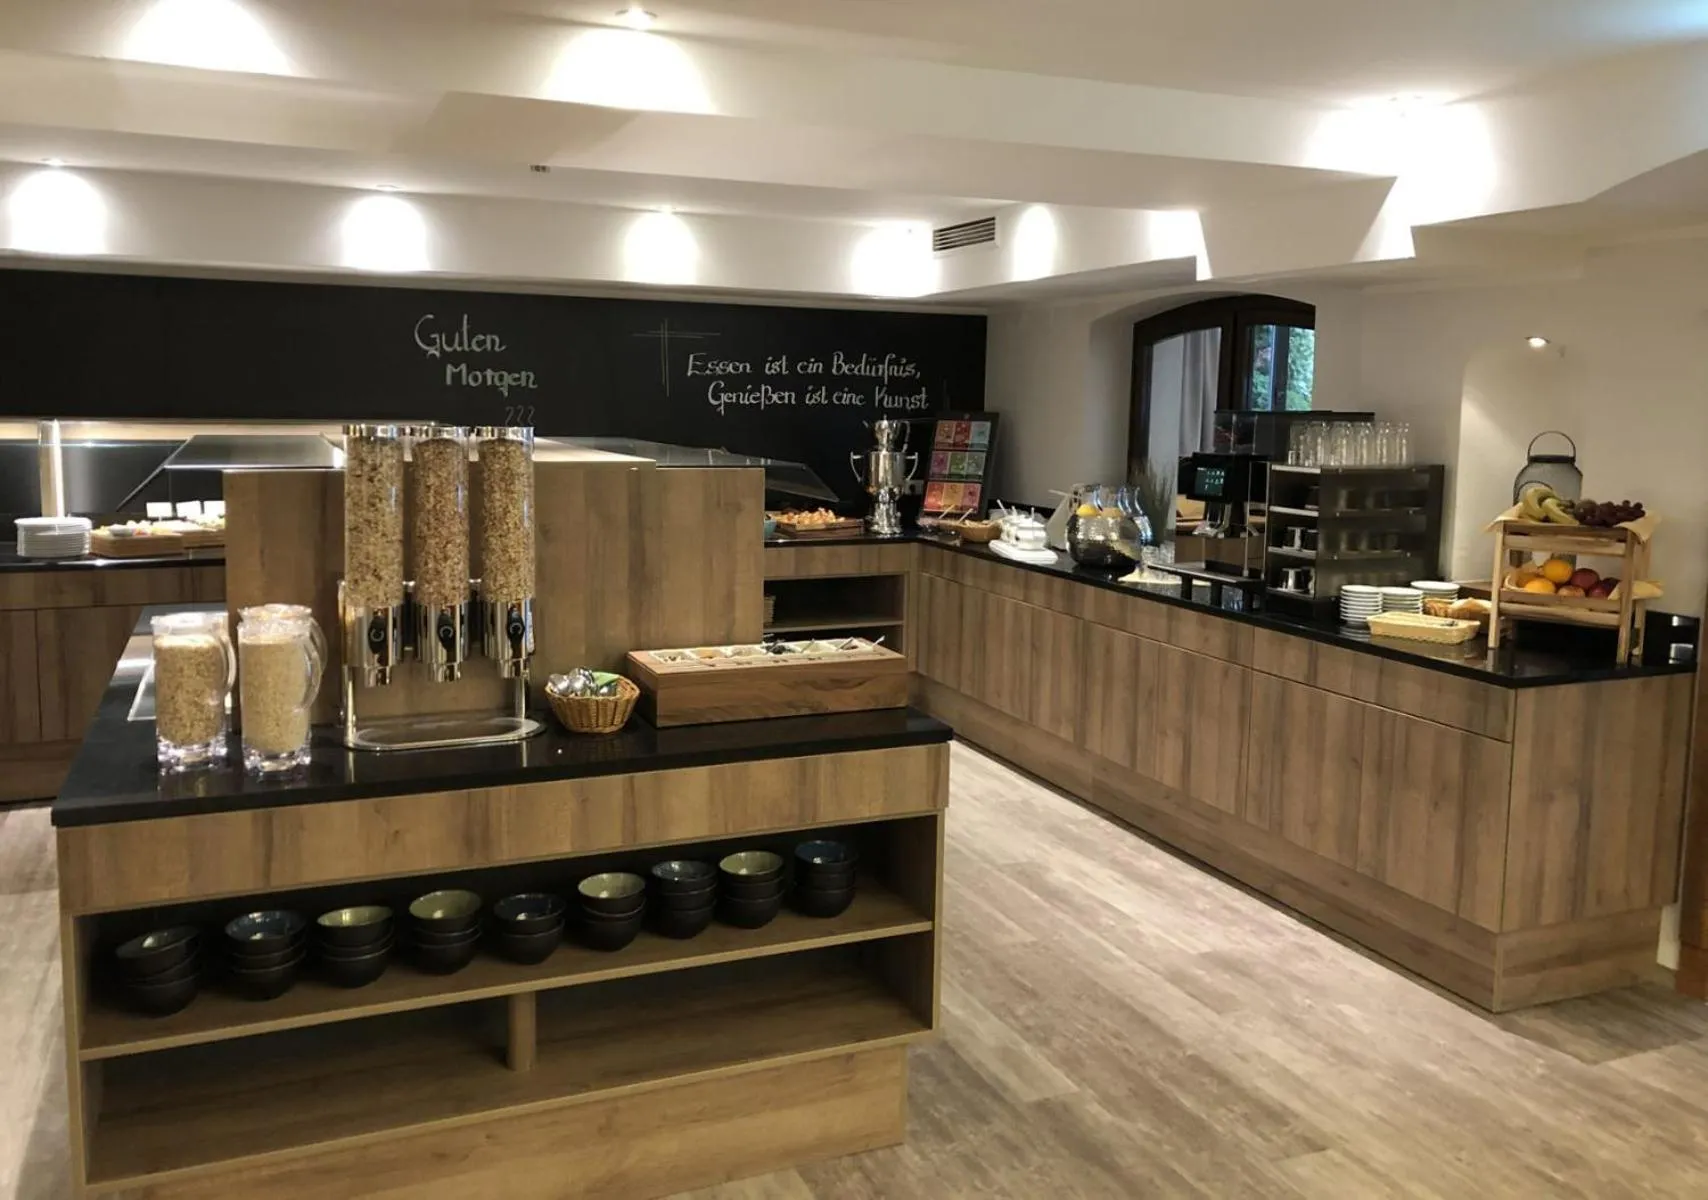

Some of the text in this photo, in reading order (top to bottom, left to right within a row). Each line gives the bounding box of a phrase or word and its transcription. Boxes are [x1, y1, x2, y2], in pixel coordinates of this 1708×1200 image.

[414, 313, 507, 359] Guten
[445, 362, 538, 397] Morgen
[687, 351, 920, 385] Essen ist ein Bedürfnis,
[708, 380, 929, 416] Genießen ist eine Kunst
